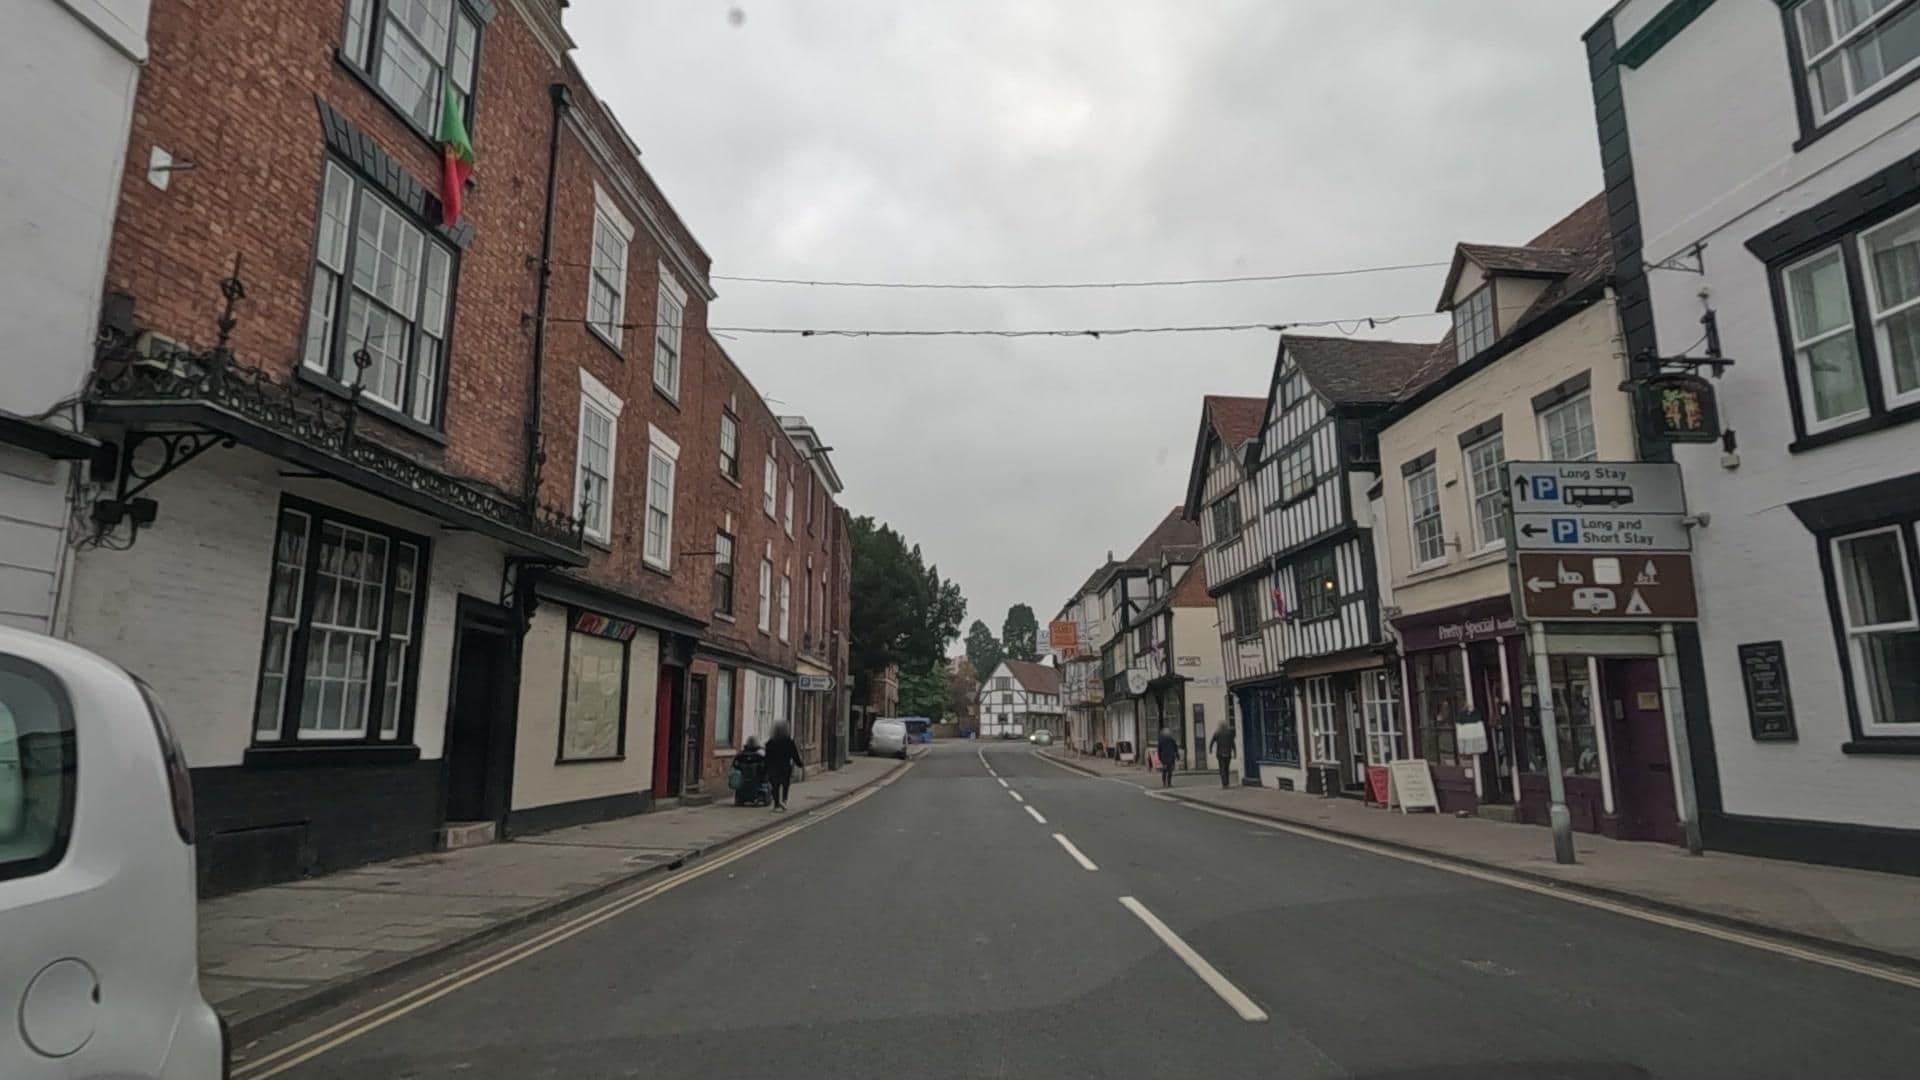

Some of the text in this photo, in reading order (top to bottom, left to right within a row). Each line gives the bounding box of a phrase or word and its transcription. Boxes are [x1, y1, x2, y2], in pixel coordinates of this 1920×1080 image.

[1559, 467, 1627, 481] Long Stay
[1536, 477, 1554, 499] P
[1556, 520, 1575, 542] P
[1581, 519, 1642, 531] Long and
[1583, 533, 1655, 545] Short Stay
